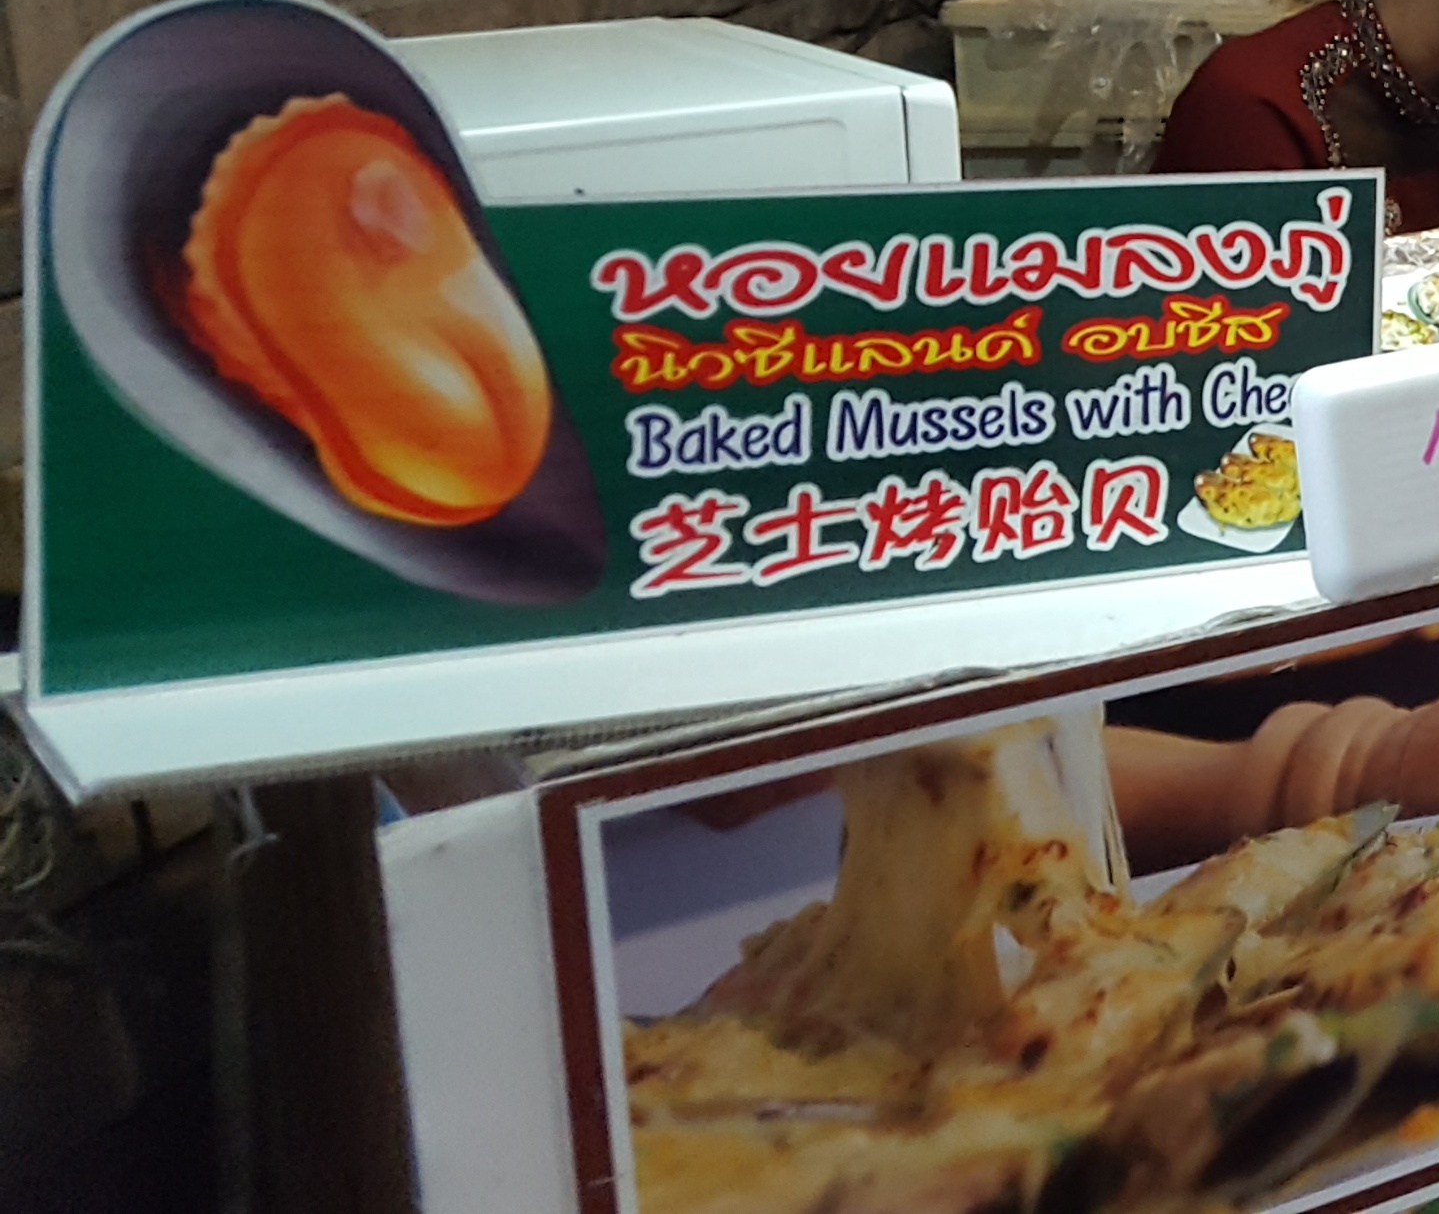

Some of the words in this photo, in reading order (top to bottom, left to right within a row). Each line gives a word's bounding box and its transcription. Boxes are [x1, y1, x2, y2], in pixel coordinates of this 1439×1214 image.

[596, 188, 1352, 319] หอยแมลงภู่
[614, 310, 1041, 390] นิวซีแลนด์
[1066, 299, 1284, 359] อบชีส
[634, 406, 806, 472] Baked
[833, 387, 1050, 458] Mussels
[1070, 368, 1184, 433] with
[1209, 364, 1295, 420] Che
[638, 460, 1165, 590] 芝士烤贻贝
